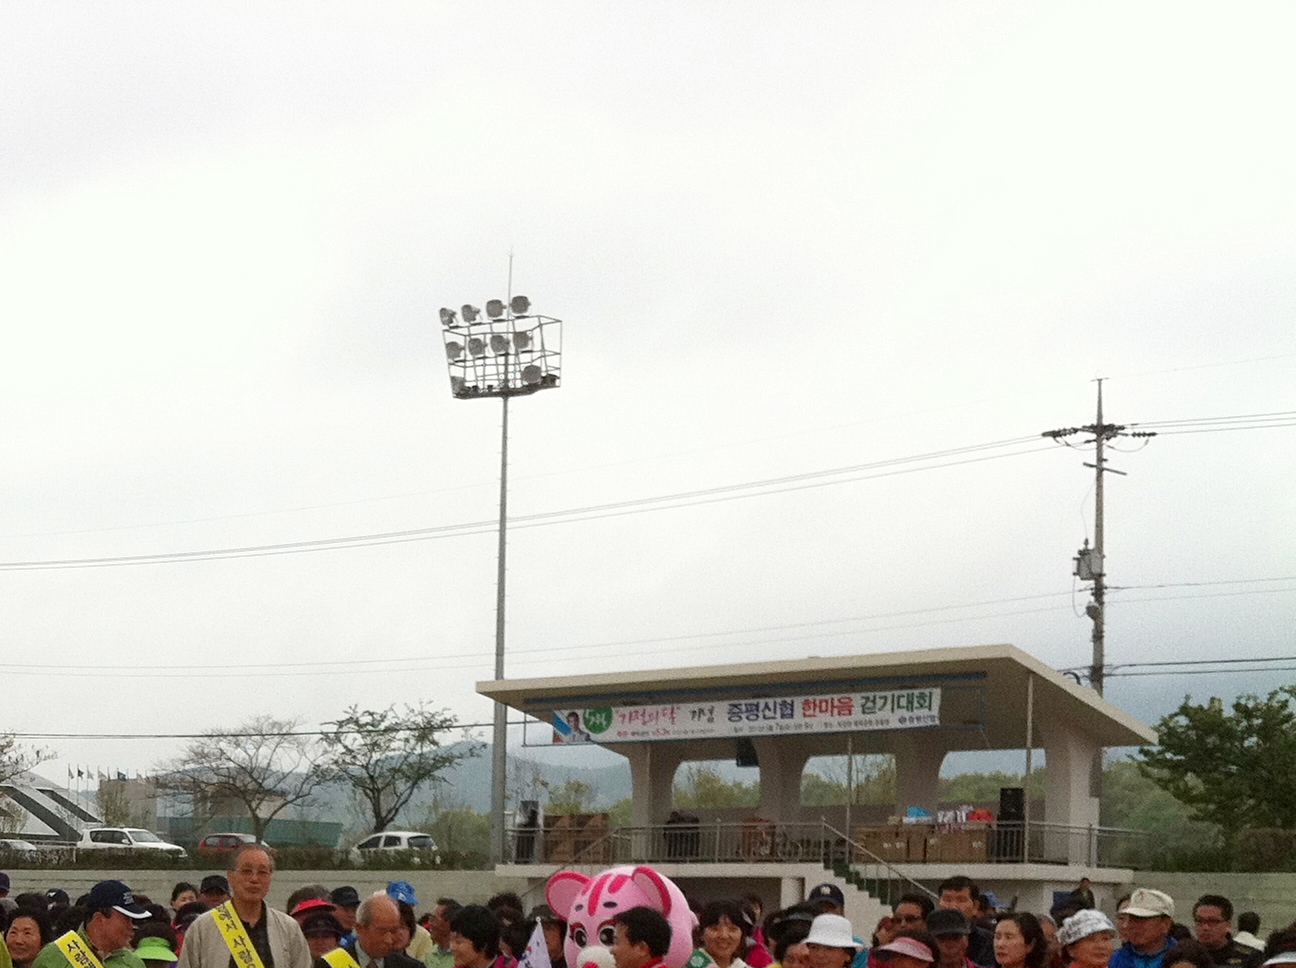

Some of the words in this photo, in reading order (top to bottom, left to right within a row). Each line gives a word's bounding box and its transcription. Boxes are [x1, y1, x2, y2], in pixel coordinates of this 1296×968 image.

[727, 700, 794, 723] 증평신협
[802, 696, 854, 718] 한마음
[860, 691, 933, 715] 걷기대회
